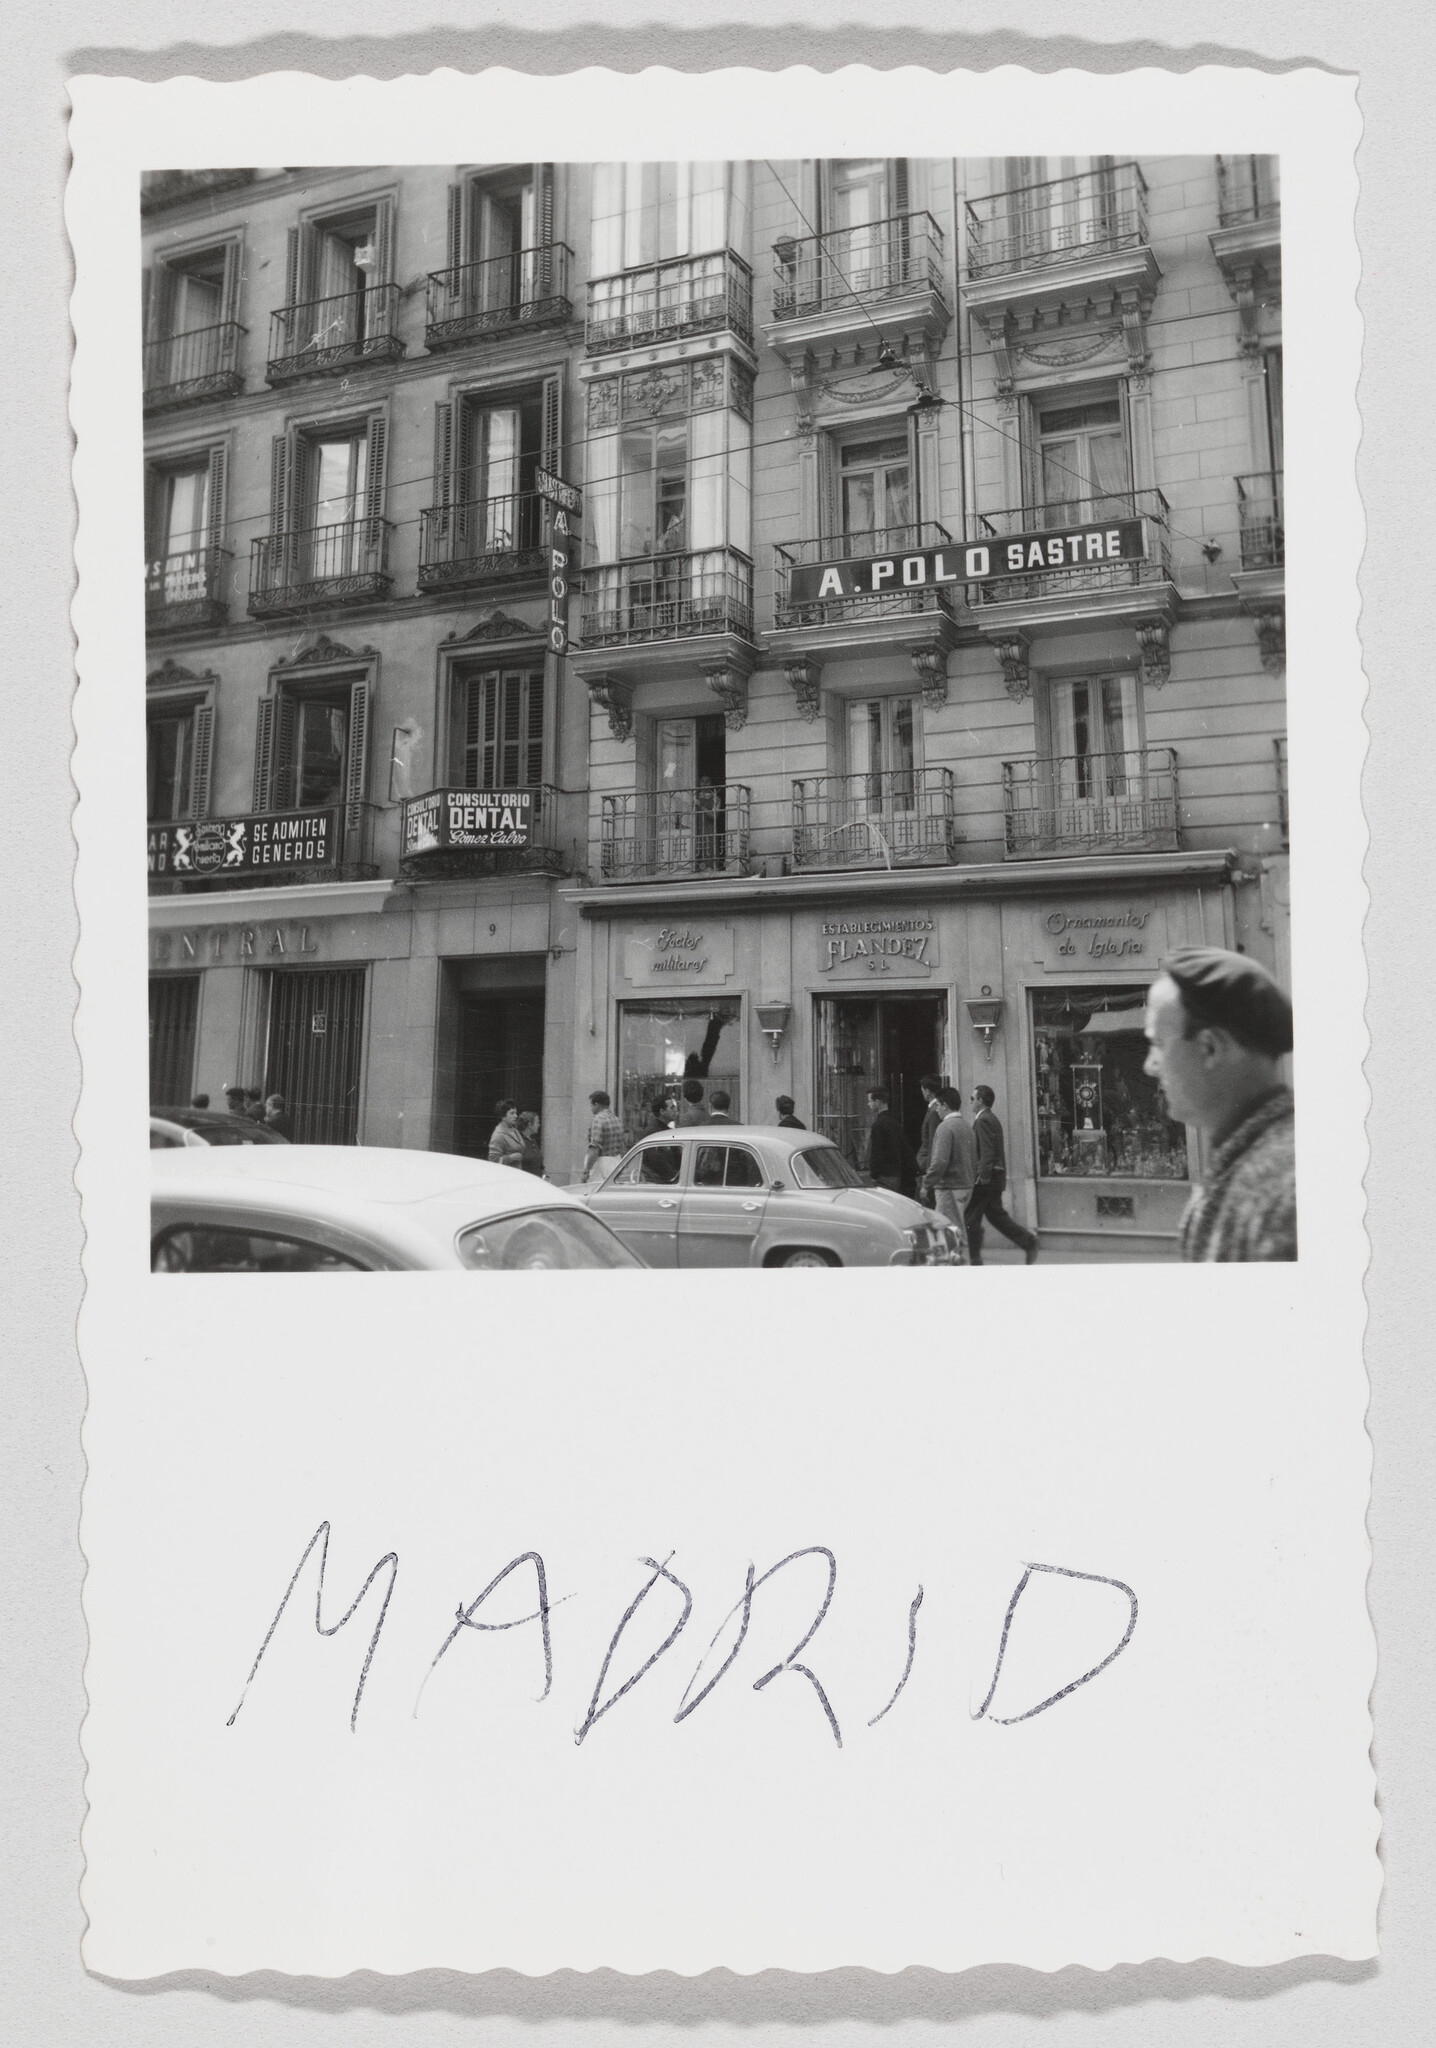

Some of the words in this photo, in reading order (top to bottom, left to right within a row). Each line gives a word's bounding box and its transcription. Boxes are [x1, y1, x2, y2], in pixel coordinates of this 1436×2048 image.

[1006, 530, 1121, 571] SASTRE
[551, 548, 568, 650] POLO
[447, 793, 530, 807] CONSULTORIO
[253, 823, 268, 842] SE
[272, 817, 327, 840] ADMITEN
[449, 807, 528, 829] DENTAL
[490, 830, 528, 845] Calvo
[252, 840, 326, 864] GENEROS
[489, 923, 496, 937] 9
[822, 919, 934, 936] ESTABLECIMIENTOS
[1047, 909, 1150, 934] Ornamentos
[827, 937, 930, 970] FLANDEZ
[1058, 936, 1076, 956] de
[1088, 933, 1142, 958] Iglesia
[226, 1520, 1139, 1748] MADRID
